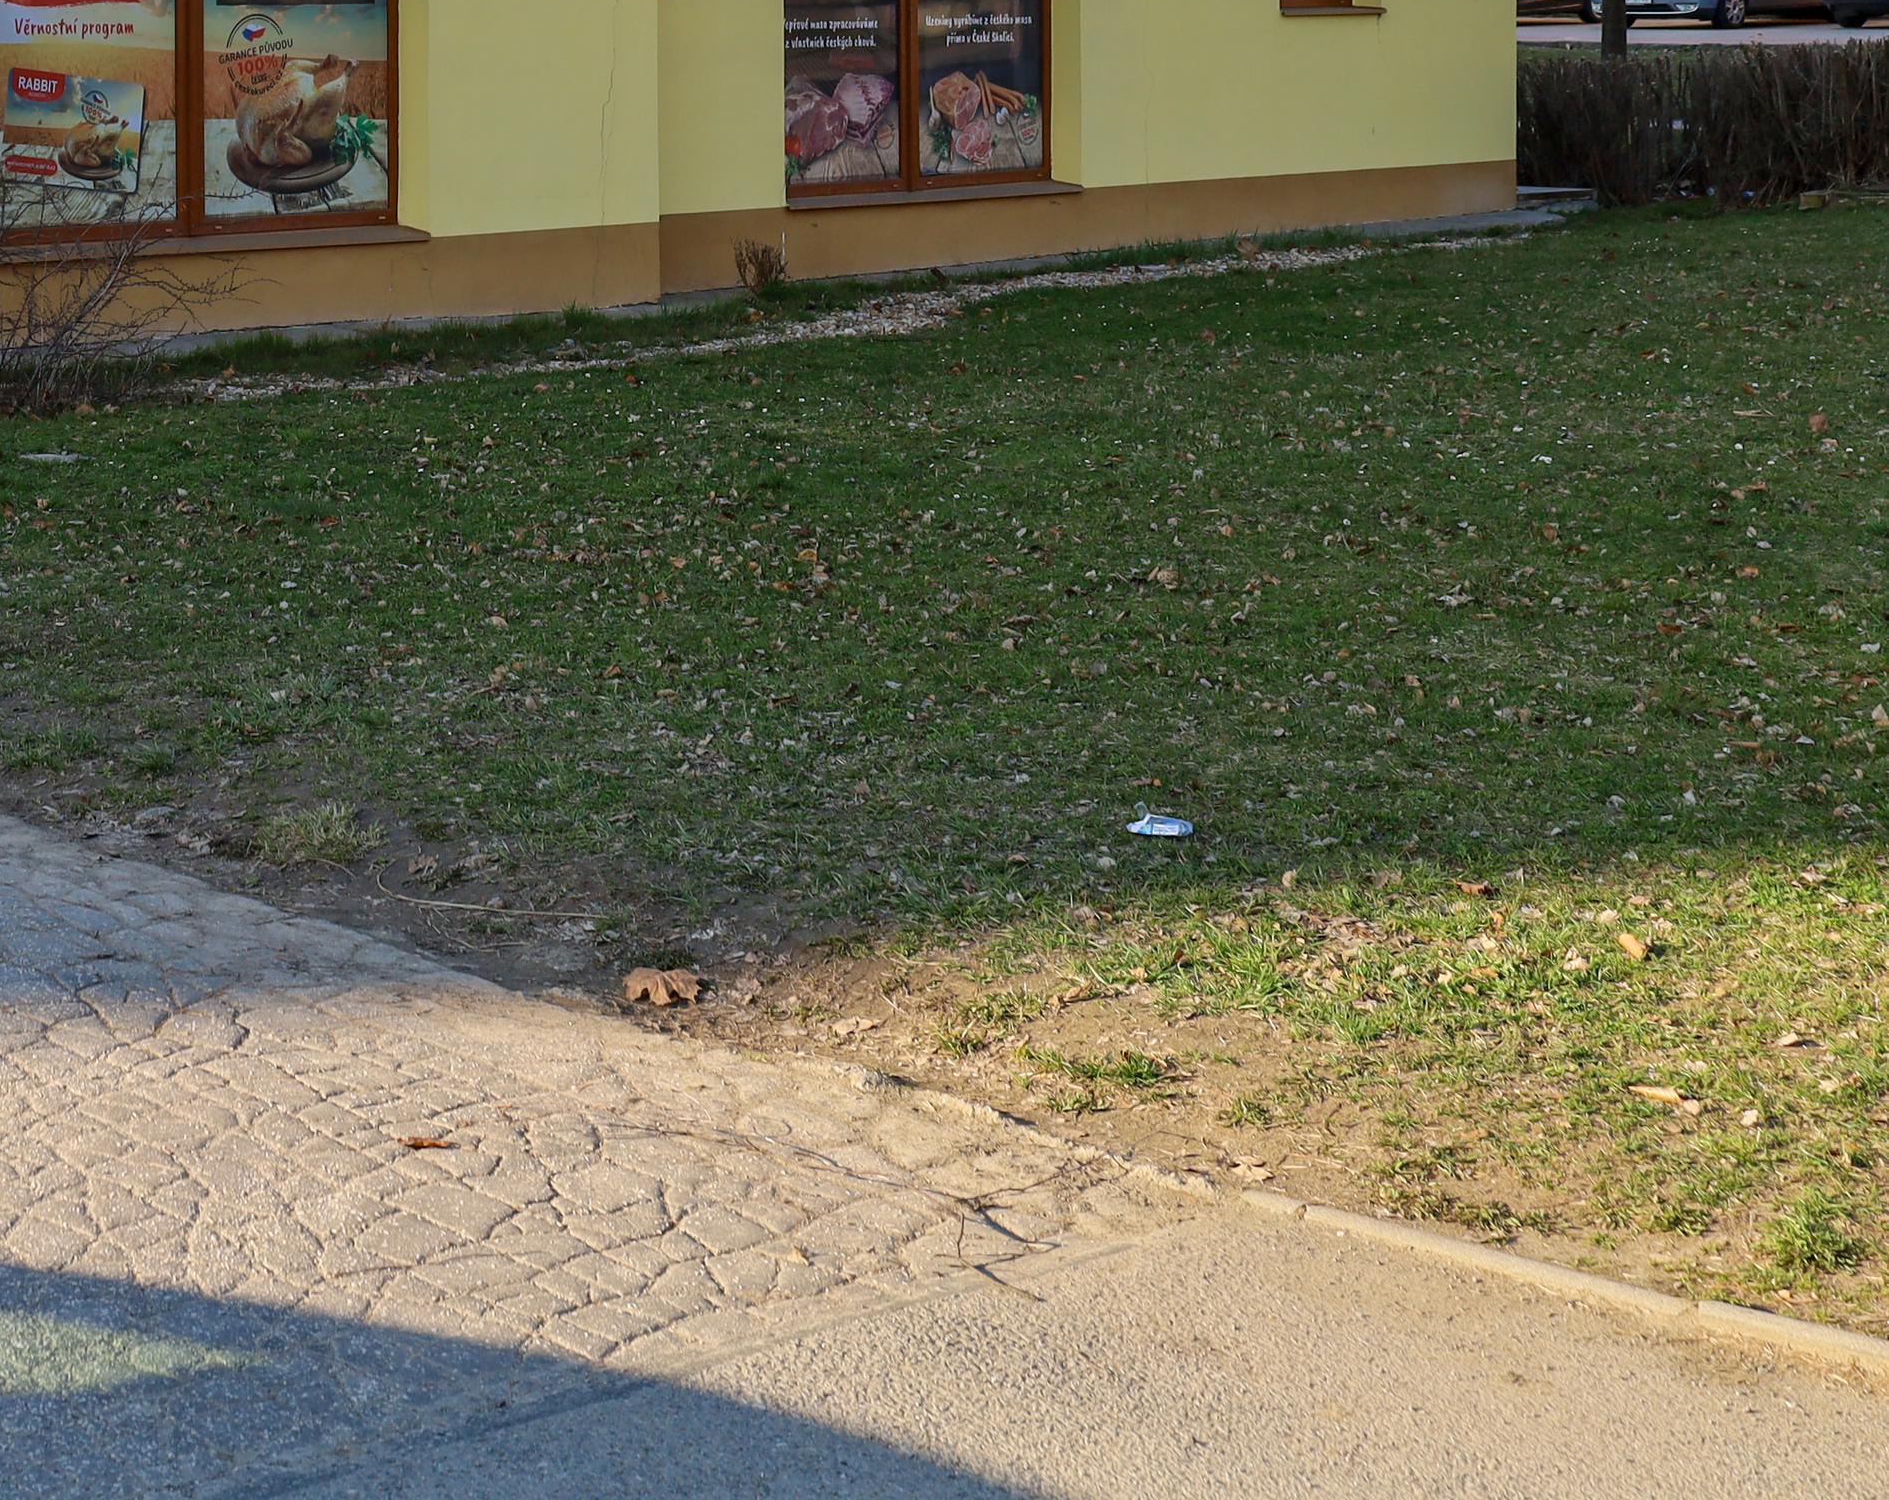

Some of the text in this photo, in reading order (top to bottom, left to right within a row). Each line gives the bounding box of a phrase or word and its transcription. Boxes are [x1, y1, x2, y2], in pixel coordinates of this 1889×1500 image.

[14, 18, 134, 39] Věrnostní program
[925, 14, 953, 28] Uzeniny
[785, 40, 790, 49] z
[791, 36, 825, 49] vlastních
[826, 35, 853, 50] českých
[966, 35, 971, 43] v
[972, 29, 991, 43] České
[218, 38, 294, 65] GARANCE PŮVODU
[237, 54, 279, 76] 100%
[18, 76, 58, 93] RABBIT
